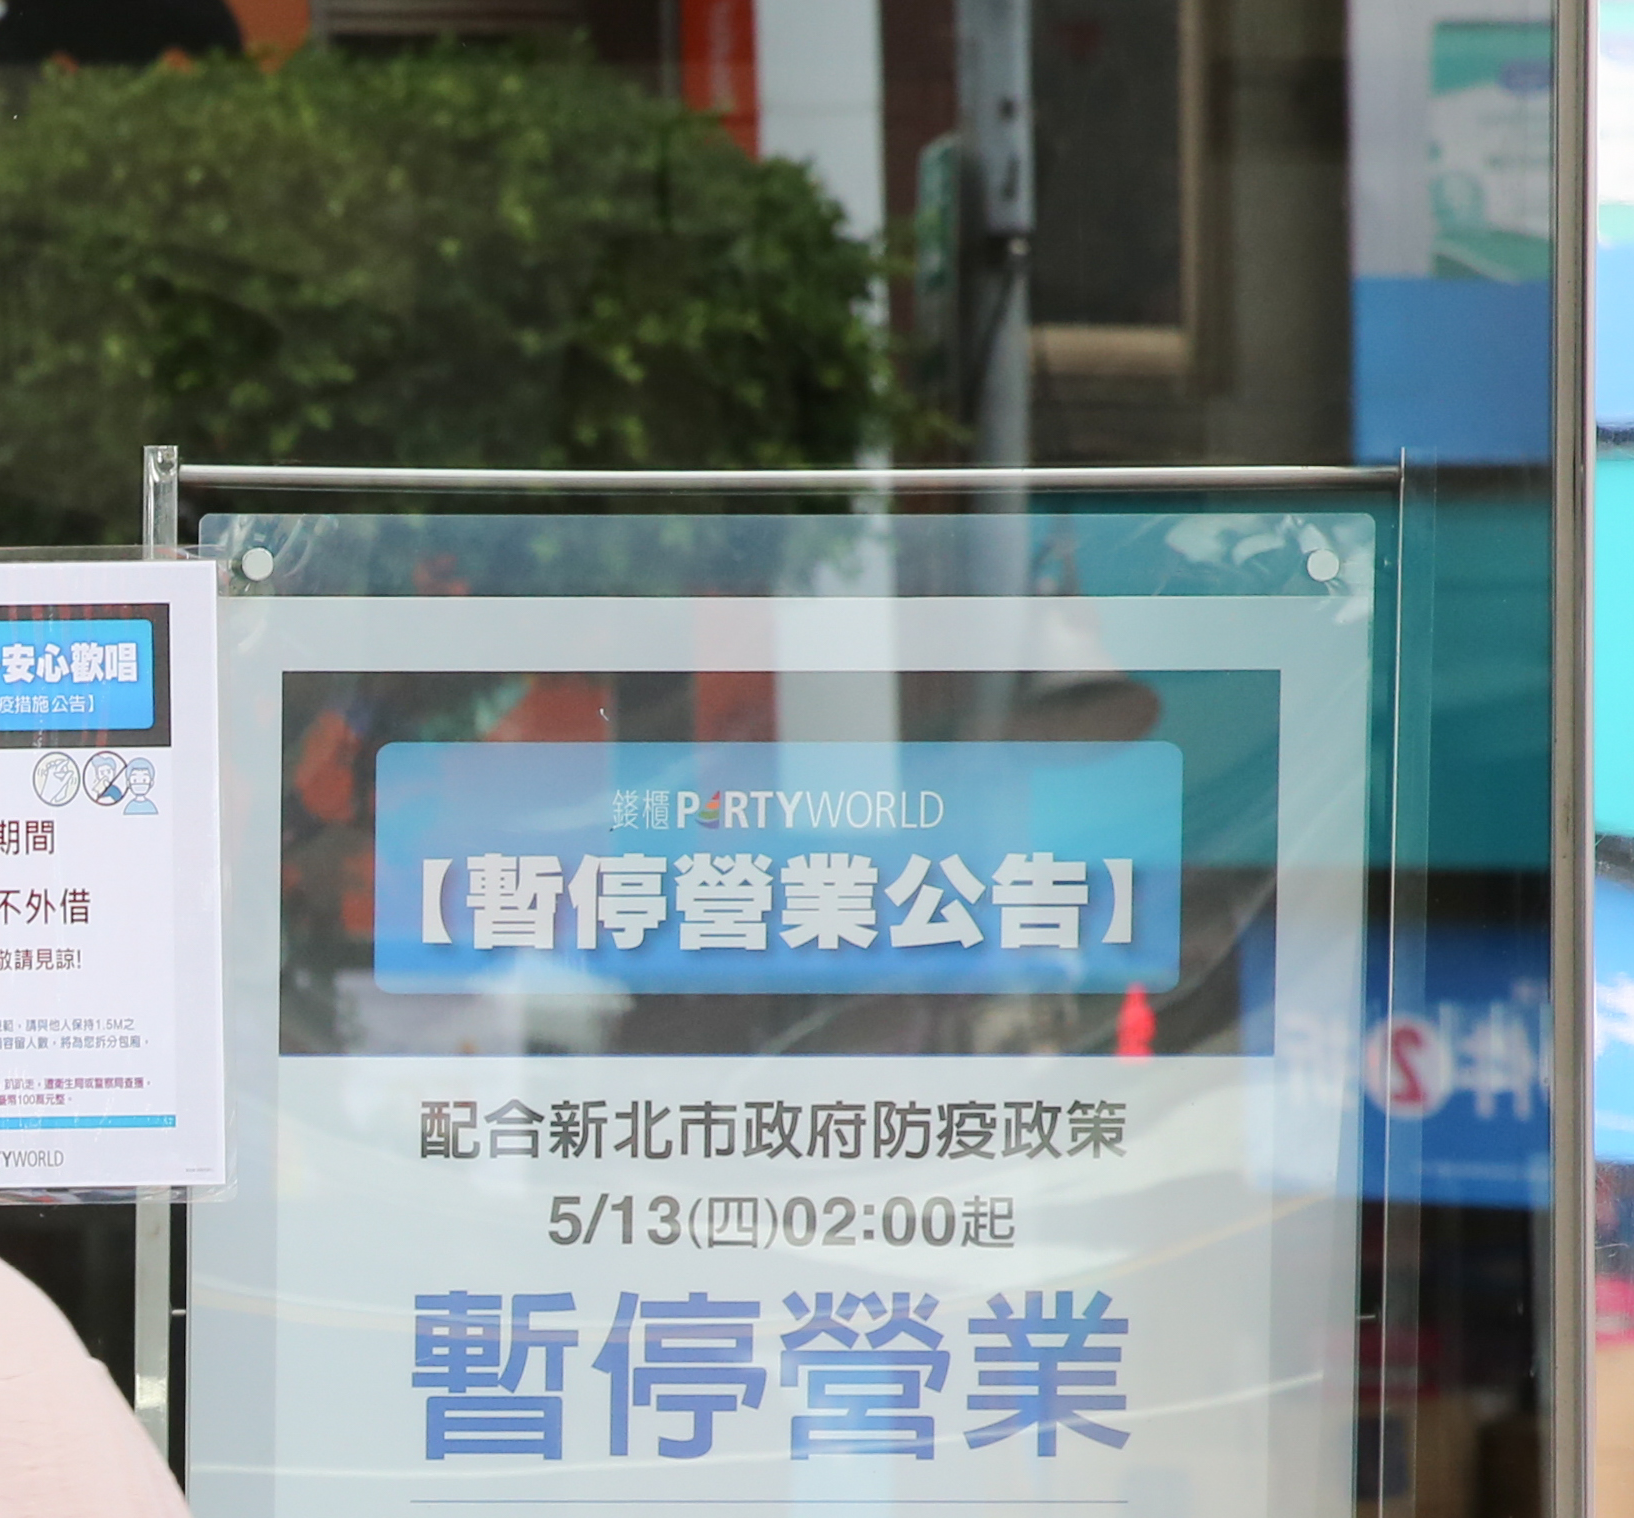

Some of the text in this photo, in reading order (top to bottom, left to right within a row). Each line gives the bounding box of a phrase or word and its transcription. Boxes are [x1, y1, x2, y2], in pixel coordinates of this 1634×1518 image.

[612, 790, 670, 830] 錢櫃
[421, 851, 1133, 951] 【暫停營業公告】
[419, 1100, 1128, 1160] 配合新北市政府防疫政策
[547, 1195, 1016, 1251] 5/13(四)02:00起
[411, 1291, 1131, 1461] 暫停營業
